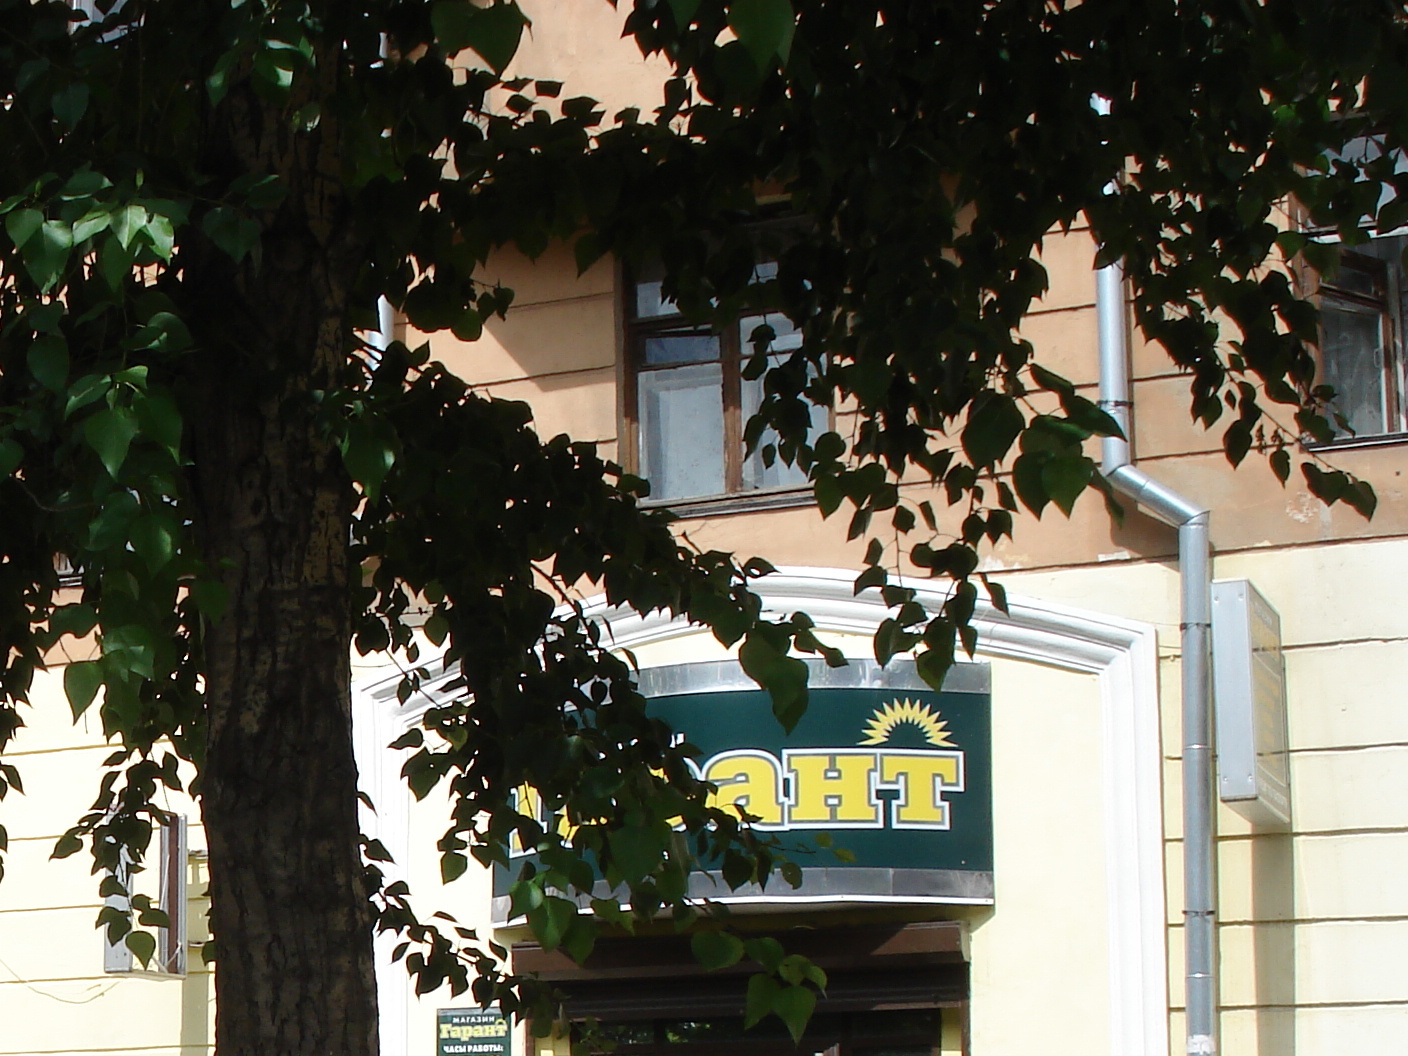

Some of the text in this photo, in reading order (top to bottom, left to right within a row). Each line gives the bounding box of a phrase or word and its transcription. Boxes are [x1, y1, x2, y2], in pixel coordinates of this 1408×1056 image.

[452, 1016, 495, 1024] МАГАЗИН
[439, 1022, 508, 1042] Гарант
[443, 1045, 467, 1054] ЧАСЫ
